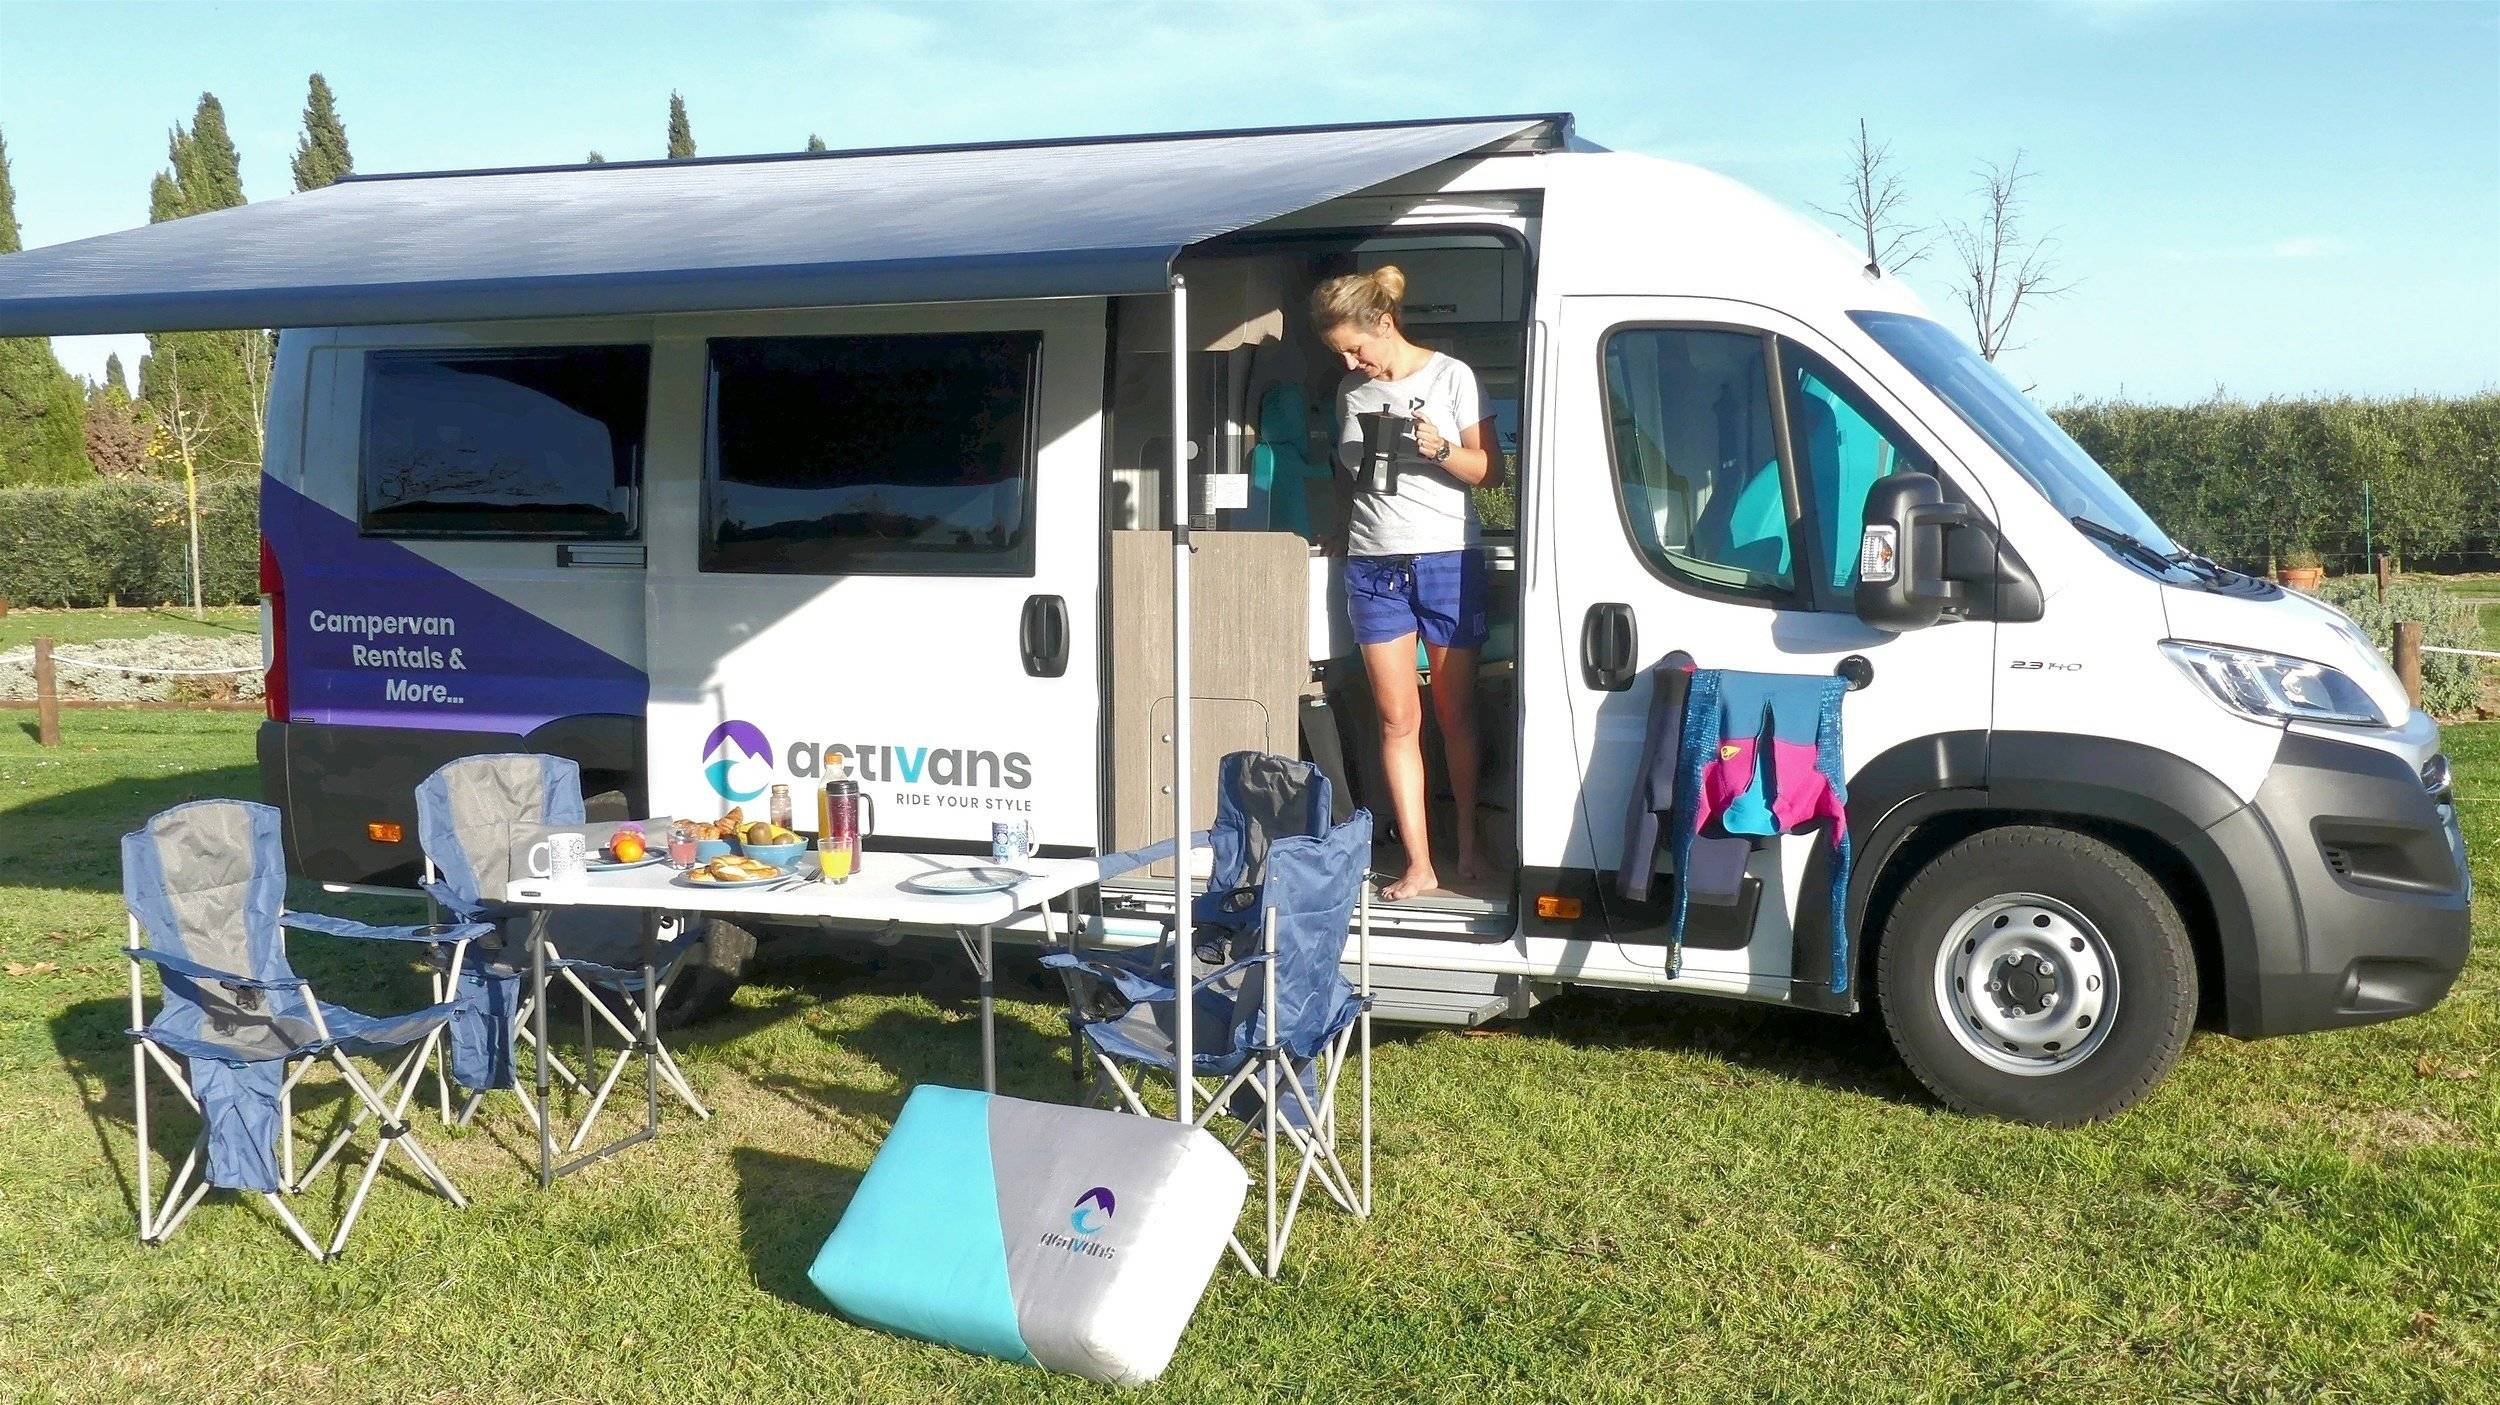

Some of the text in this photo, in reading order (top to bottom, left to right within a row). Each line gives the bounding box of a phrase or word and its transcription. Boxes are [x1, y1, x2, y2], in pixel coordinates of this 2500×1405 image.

[310, 610, 455, 640] Campervan
[352, 644, 467, 671] Rentals &
[385, 679, 465, 704] More...
[896, 793, 1033, 813] RIDE YOUR STYLE
